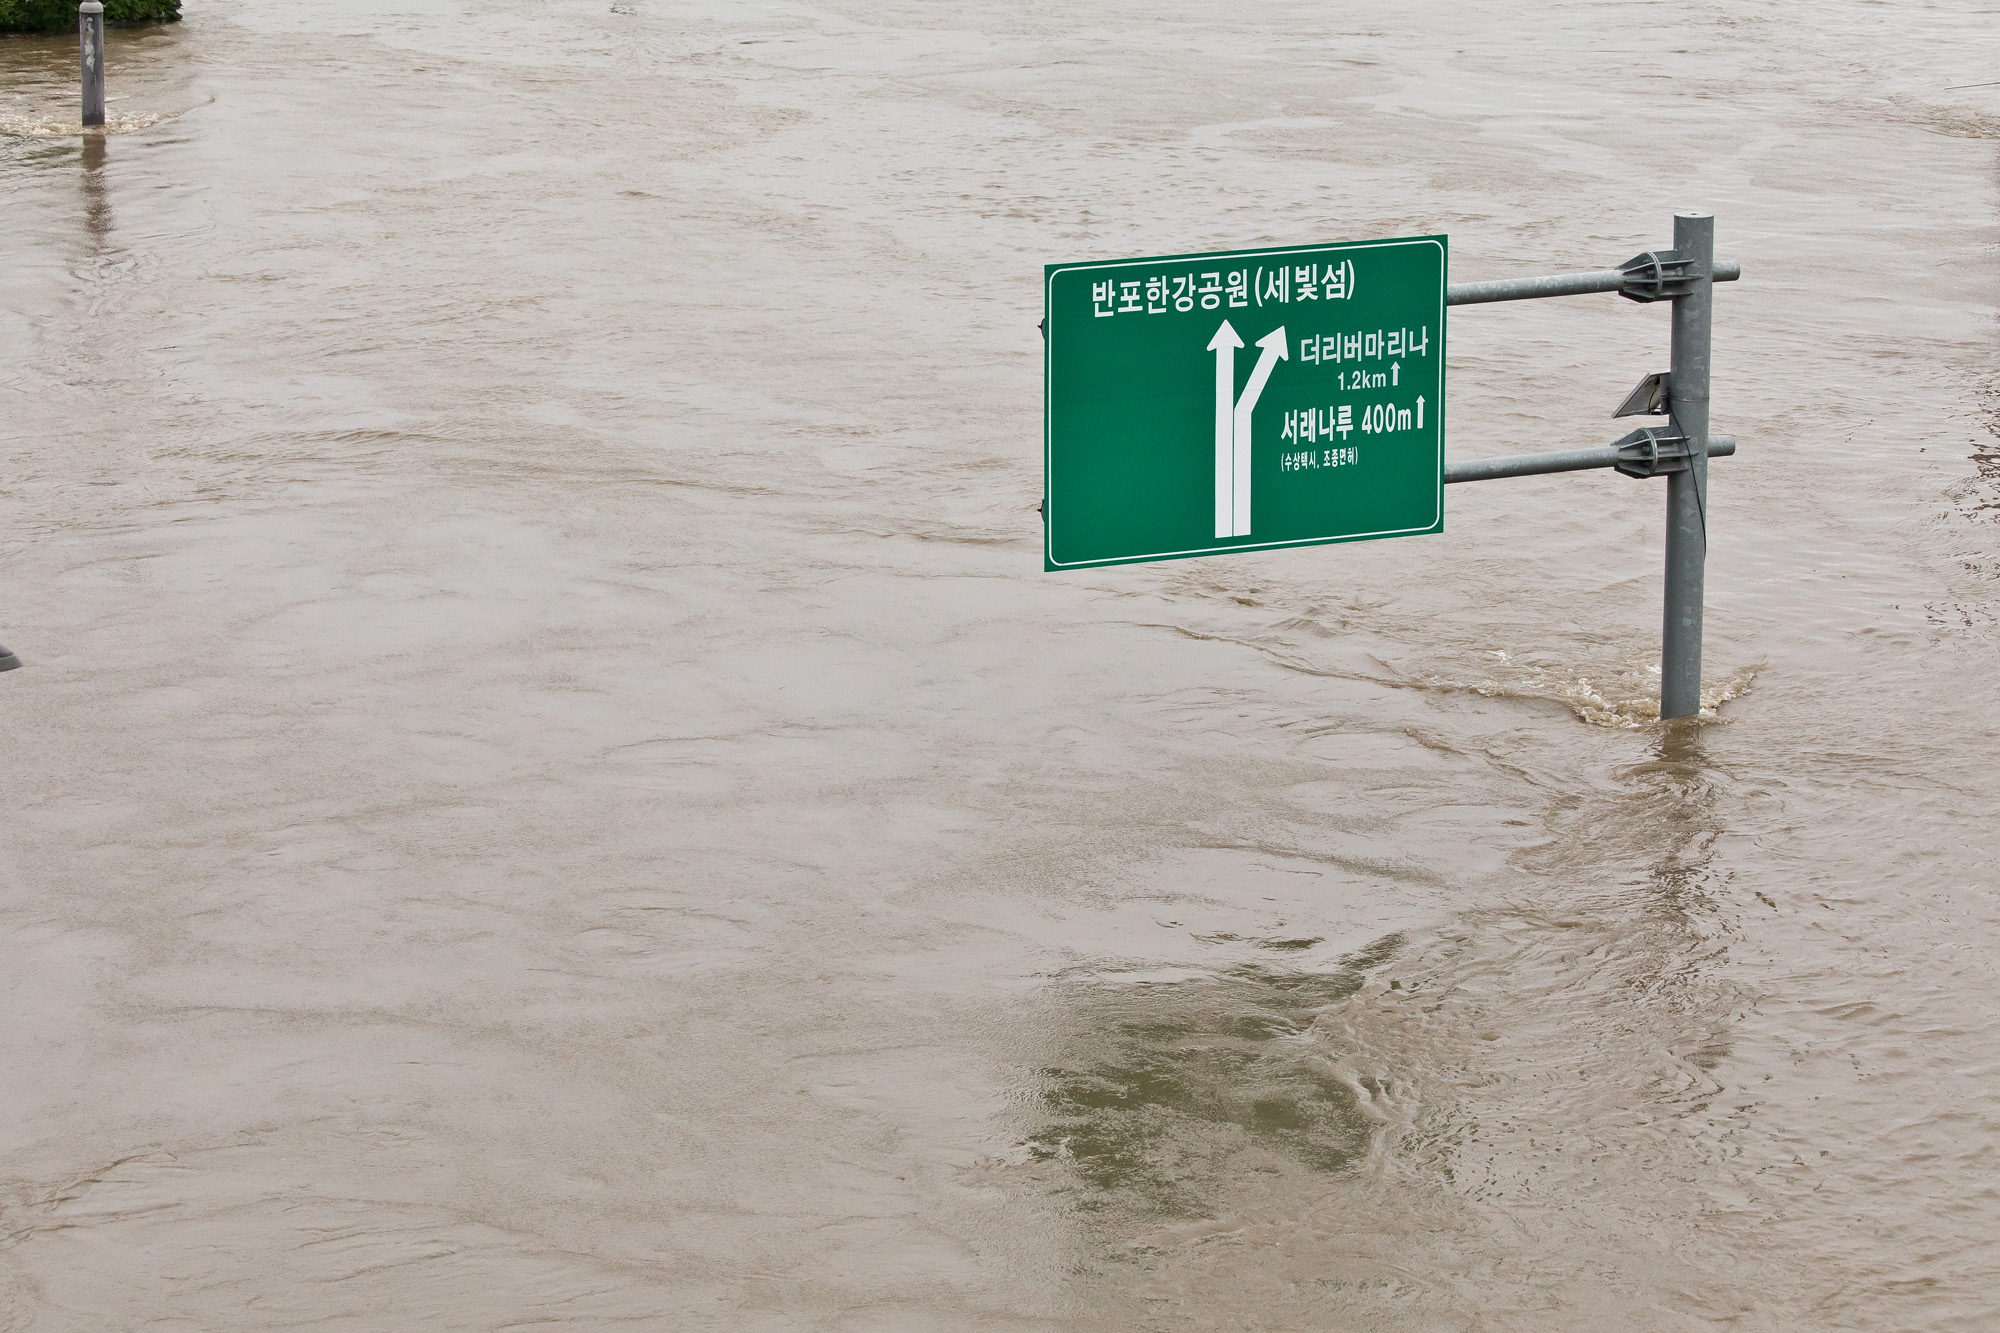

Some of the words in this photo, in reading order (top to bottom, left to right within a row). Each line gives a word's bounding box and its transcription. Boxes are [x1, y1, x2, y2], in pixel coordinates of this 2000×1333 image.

[1300, 326, 1429, 365] 더리버마리나
[1338, 369, 1387, 391] 1.2km
[1280, 404, 1354, 445] 서래나루
[1361, 402, 1412, 435] 400m
[1323, 446, 1359, 467] 조종면허)
